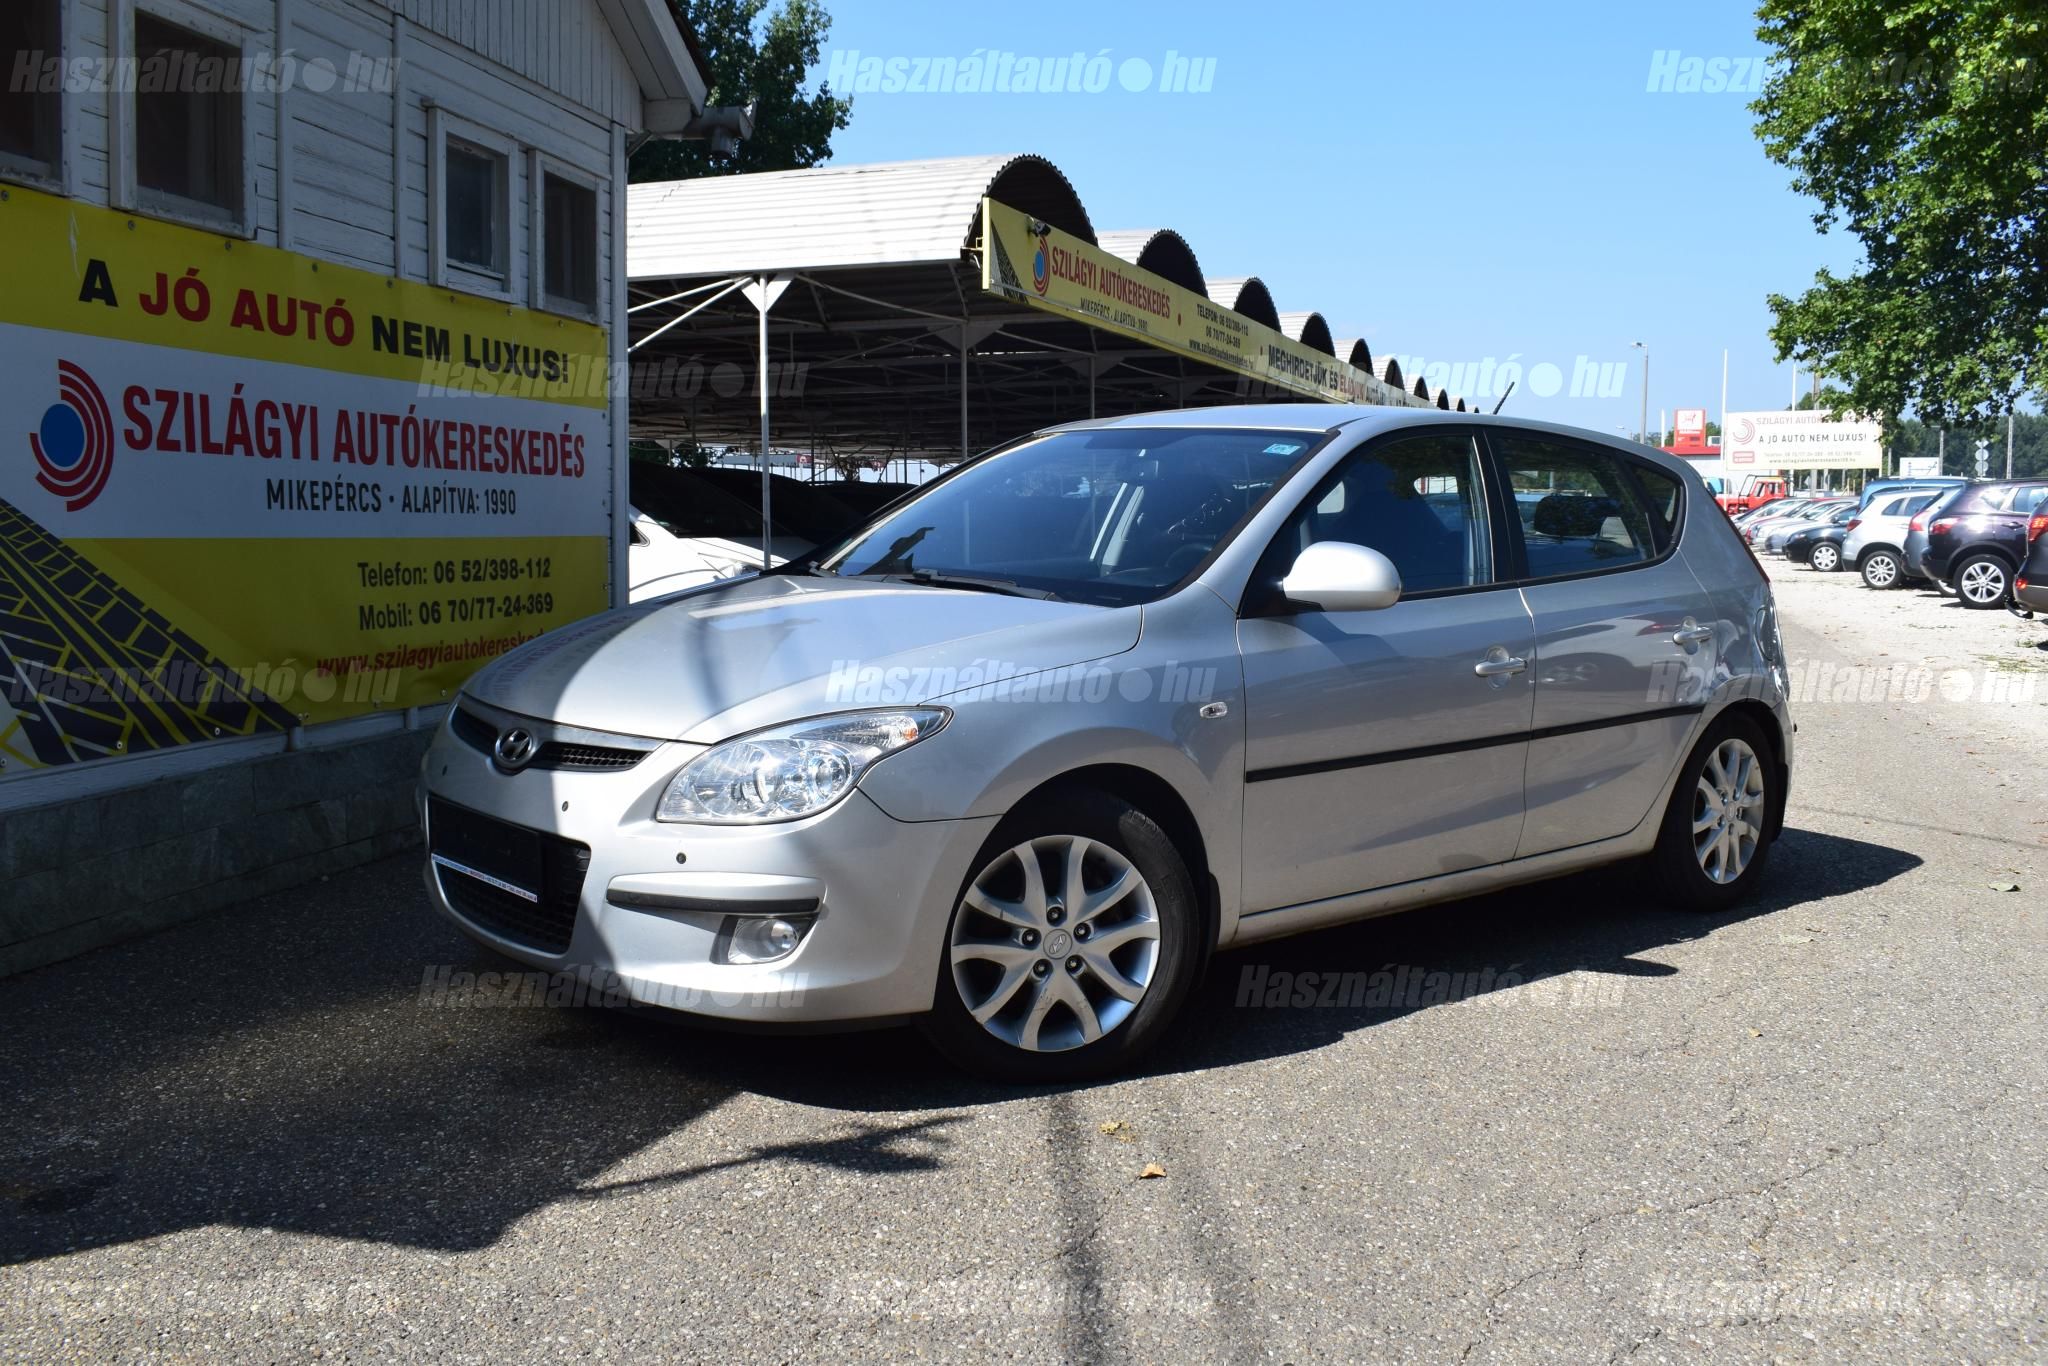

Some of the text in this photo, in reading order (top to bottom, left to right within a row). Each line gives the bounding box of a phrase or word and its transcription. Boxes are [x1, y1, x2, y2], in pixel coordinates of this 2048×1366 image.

[1052, 246, 1170, 319] SZILÁGYI AUTÓKERESKEDÉS
[79, 259, 568, 384] A JÓ AUTÓ NEM LUXUS!
[123, 383, 584, 478] SZILÁGYI AUTÓKERESKEDÉS
[1809, 433, 1829, 442] NEM
[266, 474, 516, 515] MIKEPÉRCS ALAPÍTVA: 1990
[357, 557, 551, 587] Telefon: 06 52/398-112
[359, 592, 553, 630] Mobil: 06 70/77-24-369
